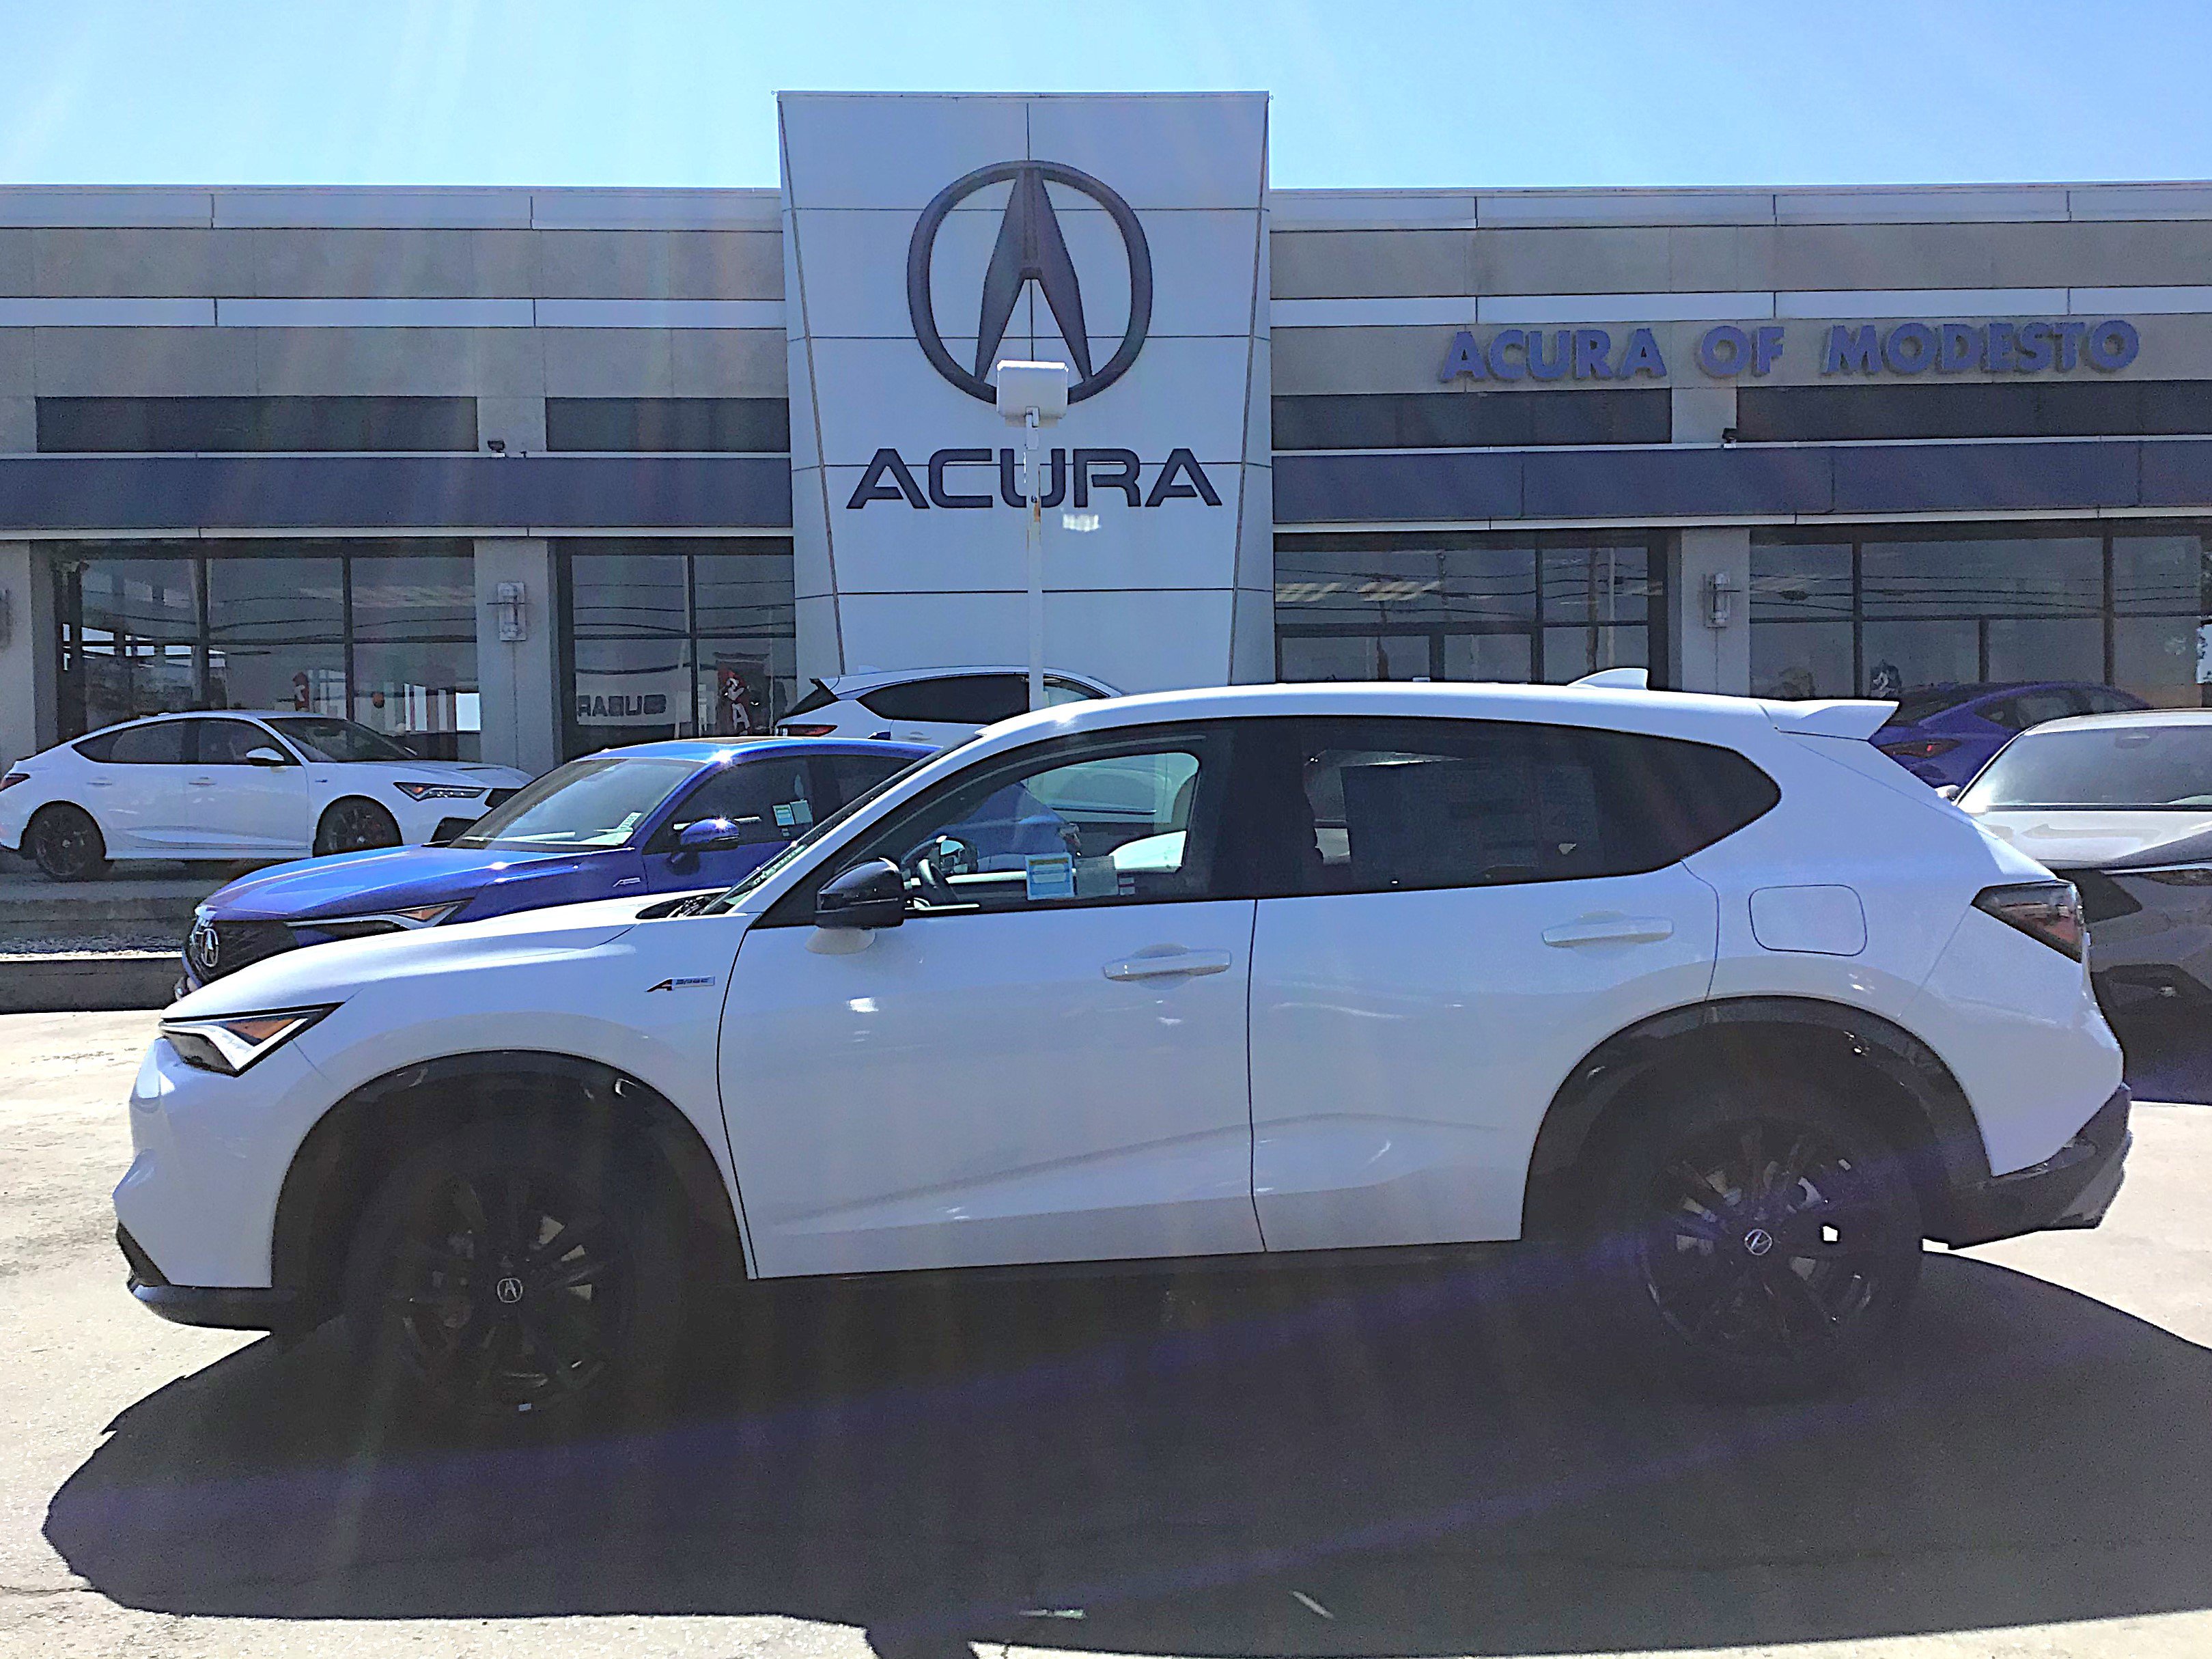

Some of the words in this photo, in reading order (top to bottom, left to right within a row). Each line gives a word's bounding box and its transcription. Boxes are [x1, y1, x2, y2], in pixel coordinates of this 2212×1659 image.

[1439, 327, 1668, 382] ACURA
[1697, 325, 1785, 378] OF
[1824, 319, 2140, 374] MODESTO
[845, 448, 1223, 510] ACURA
